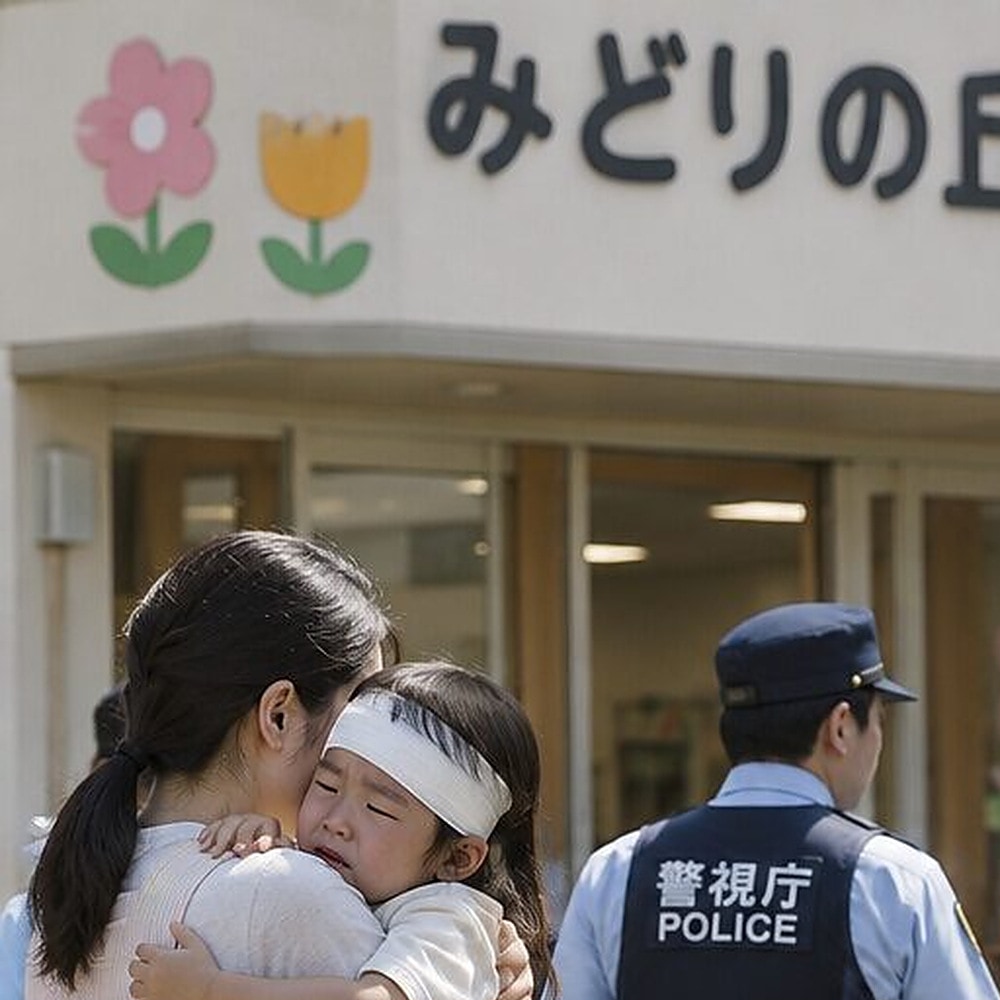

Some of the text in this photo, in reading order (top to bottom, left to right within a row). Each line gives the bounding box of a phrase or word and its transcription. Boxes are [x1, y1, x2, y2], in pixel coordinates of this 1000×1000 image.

[656, 859, 813, 909] 警視庁
[658, 911, 798, 944] POLICE
